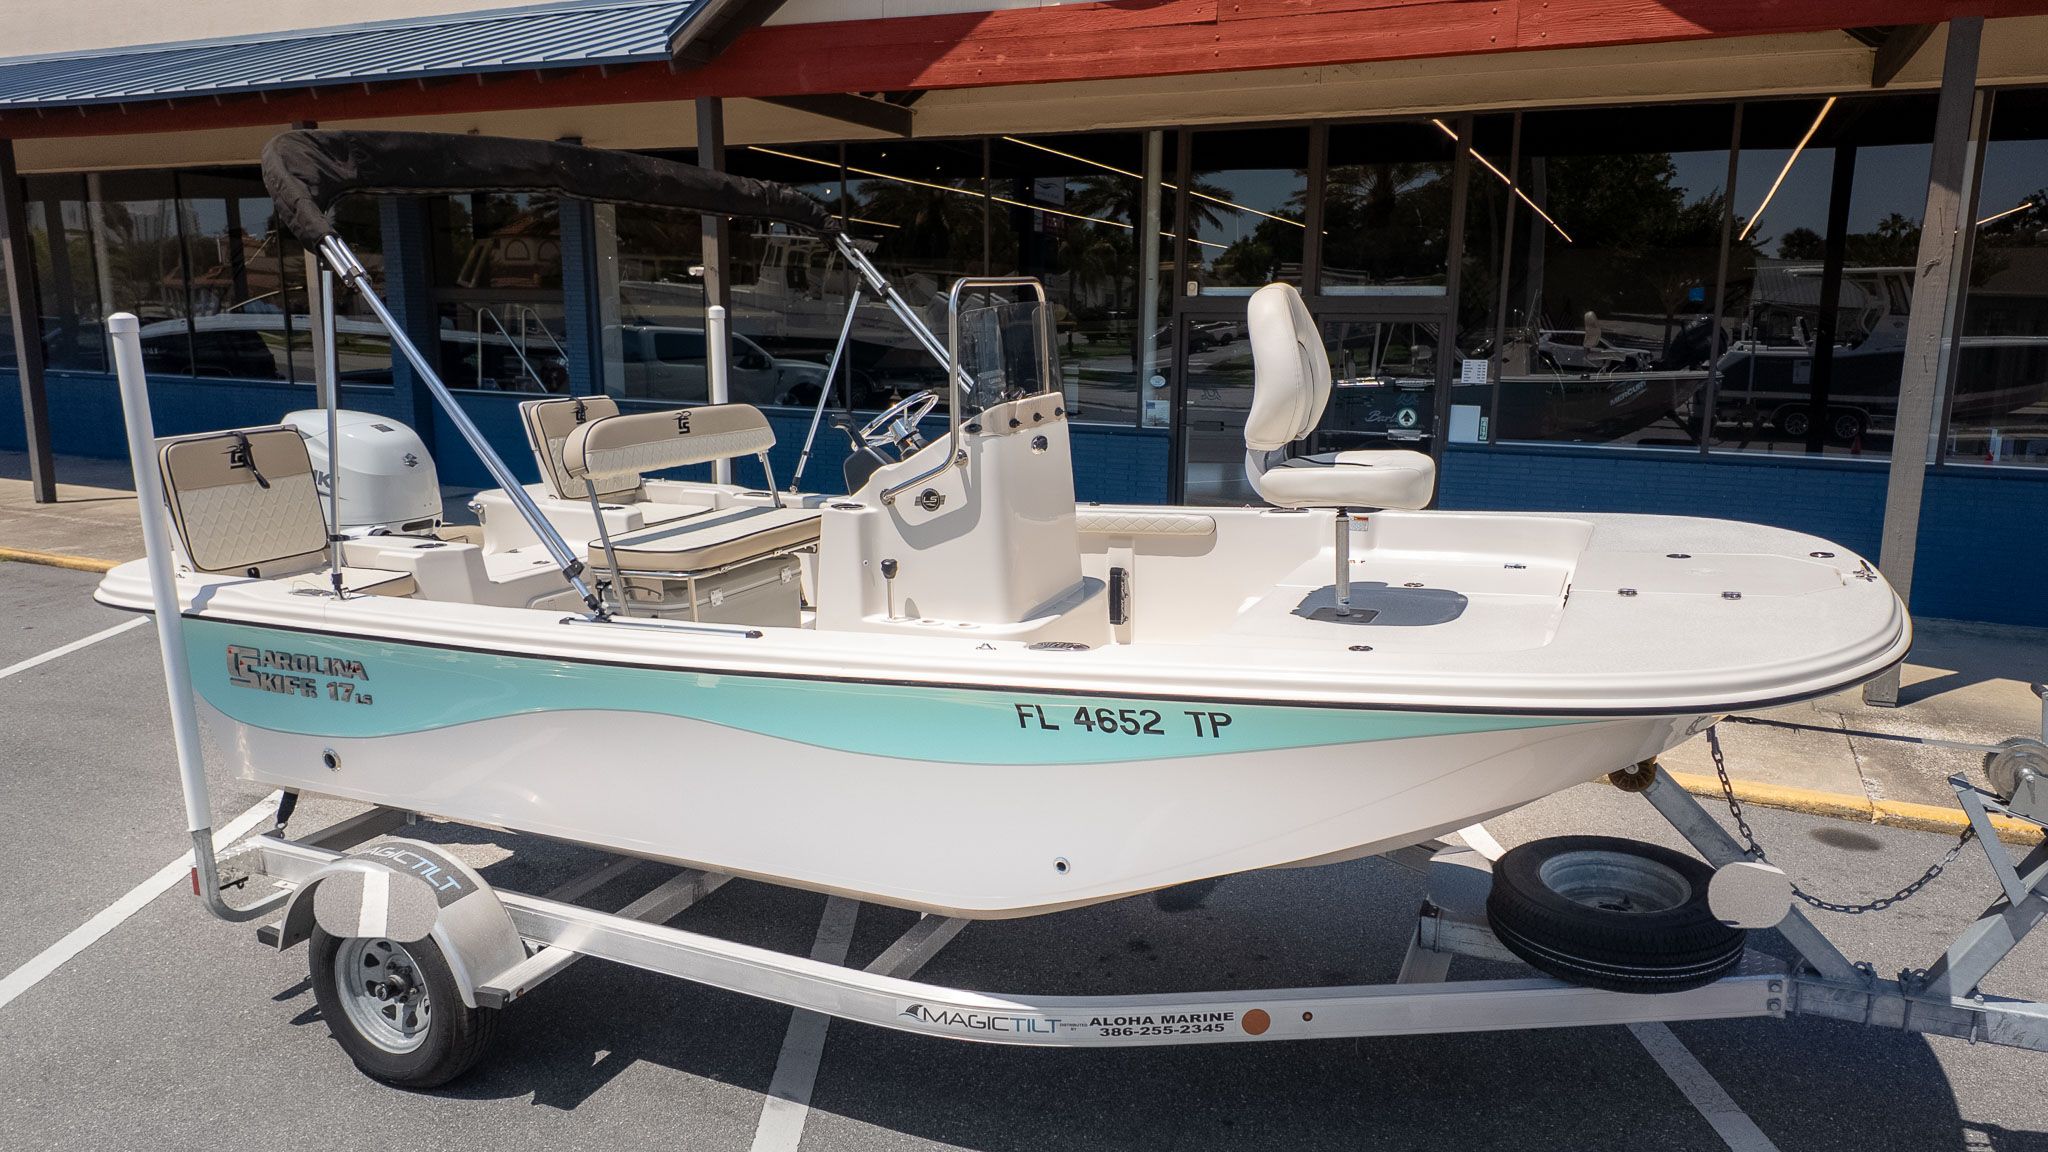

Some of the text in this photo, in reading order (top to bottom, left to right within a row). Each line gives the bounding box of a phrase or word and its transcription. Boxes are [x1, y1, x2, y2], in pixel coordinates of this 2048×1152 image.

[226, 644, 370, 681] CAROLINA
[326, 681, 355, 702] 17
[1014, 703, 1233, 738] FL 4652 TP
[366, 846, 462, 891] AGICTILT
[923, 1007, 1062, 1034] MAGICTILT
[1089, 1011, 1235, 1027] ALOHA MARINE
[1099, 1023, 1225, 1037] 386-255-2345
